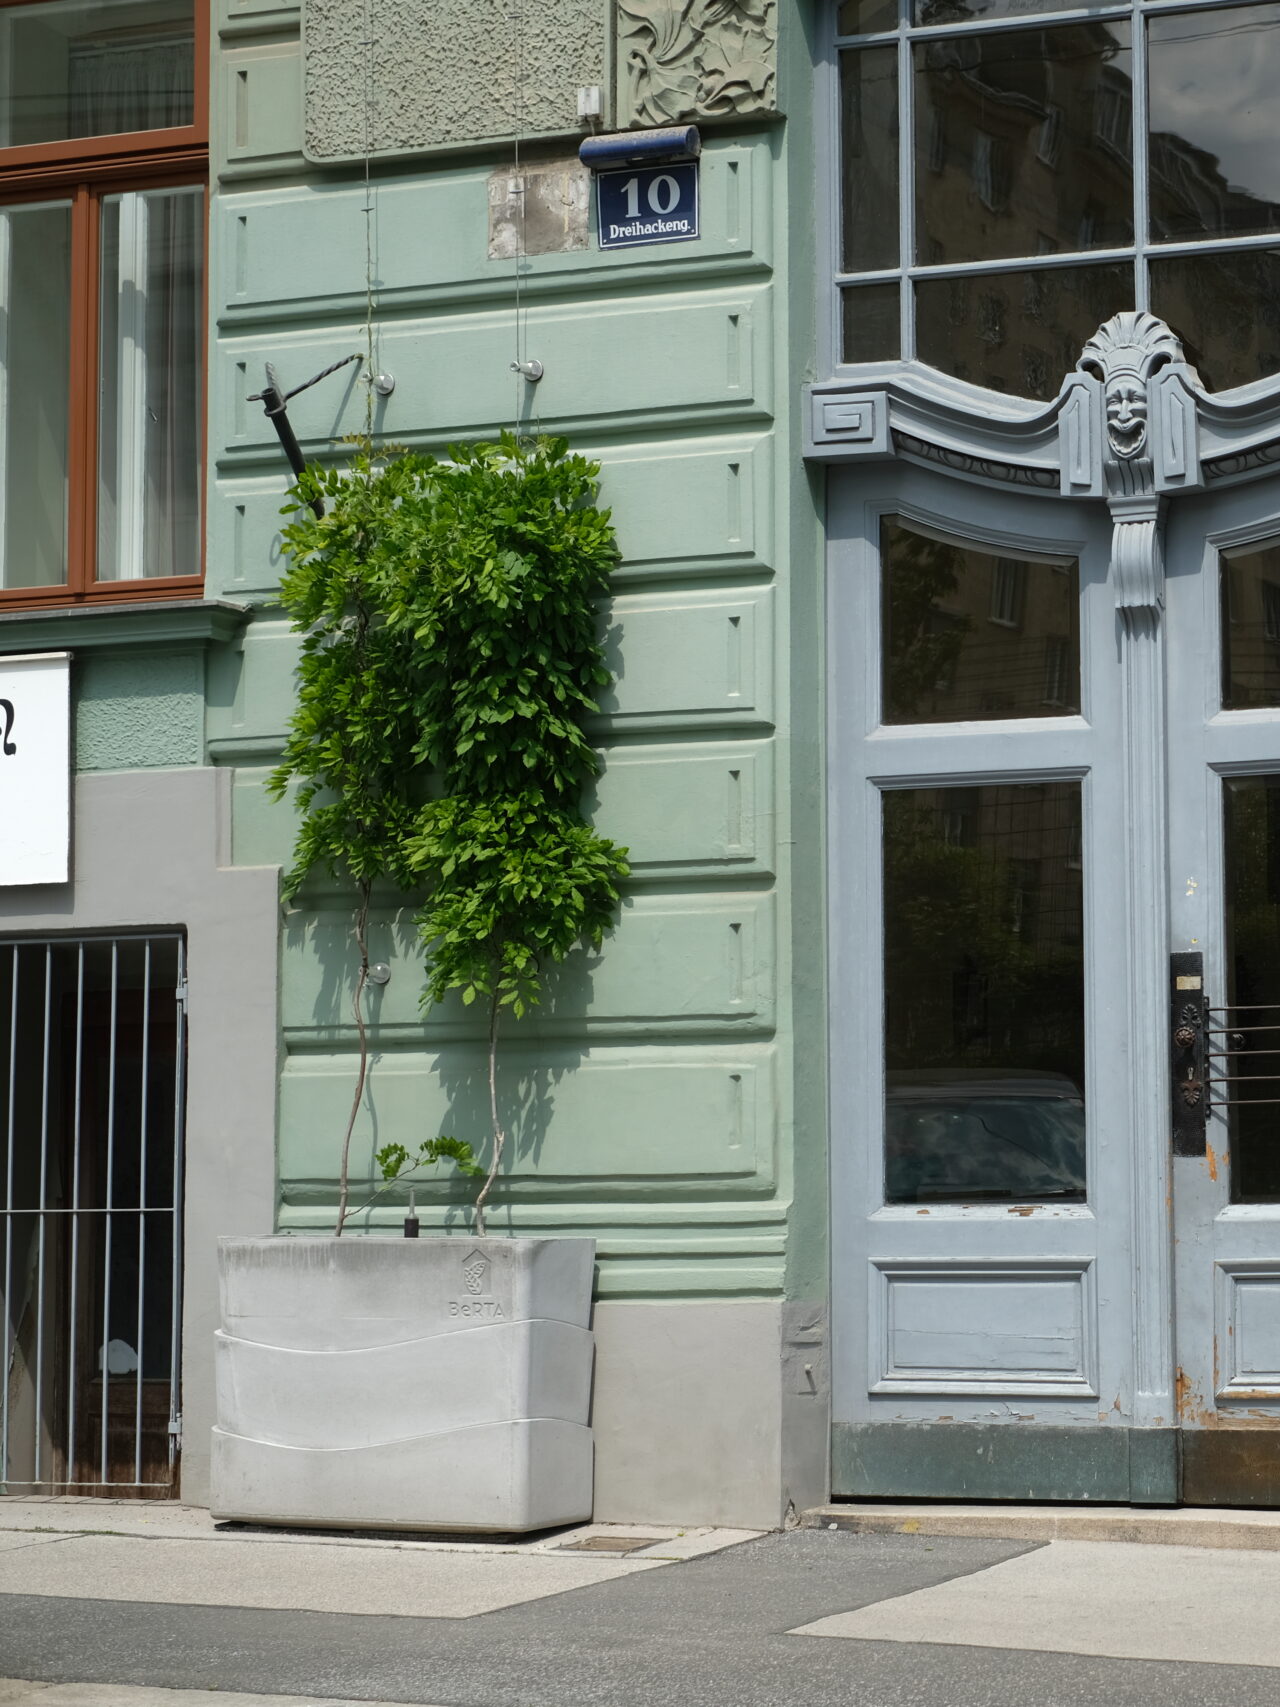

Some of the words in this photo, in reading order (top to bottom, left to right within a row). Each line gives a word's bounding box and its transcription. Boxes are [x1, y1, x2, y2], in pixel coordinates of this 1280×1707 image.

[620, 174, 681, 218] 10
[609, 219, 692, 239] Dreihackeng.
[448, 1301, 505, 1319] BeRTA
